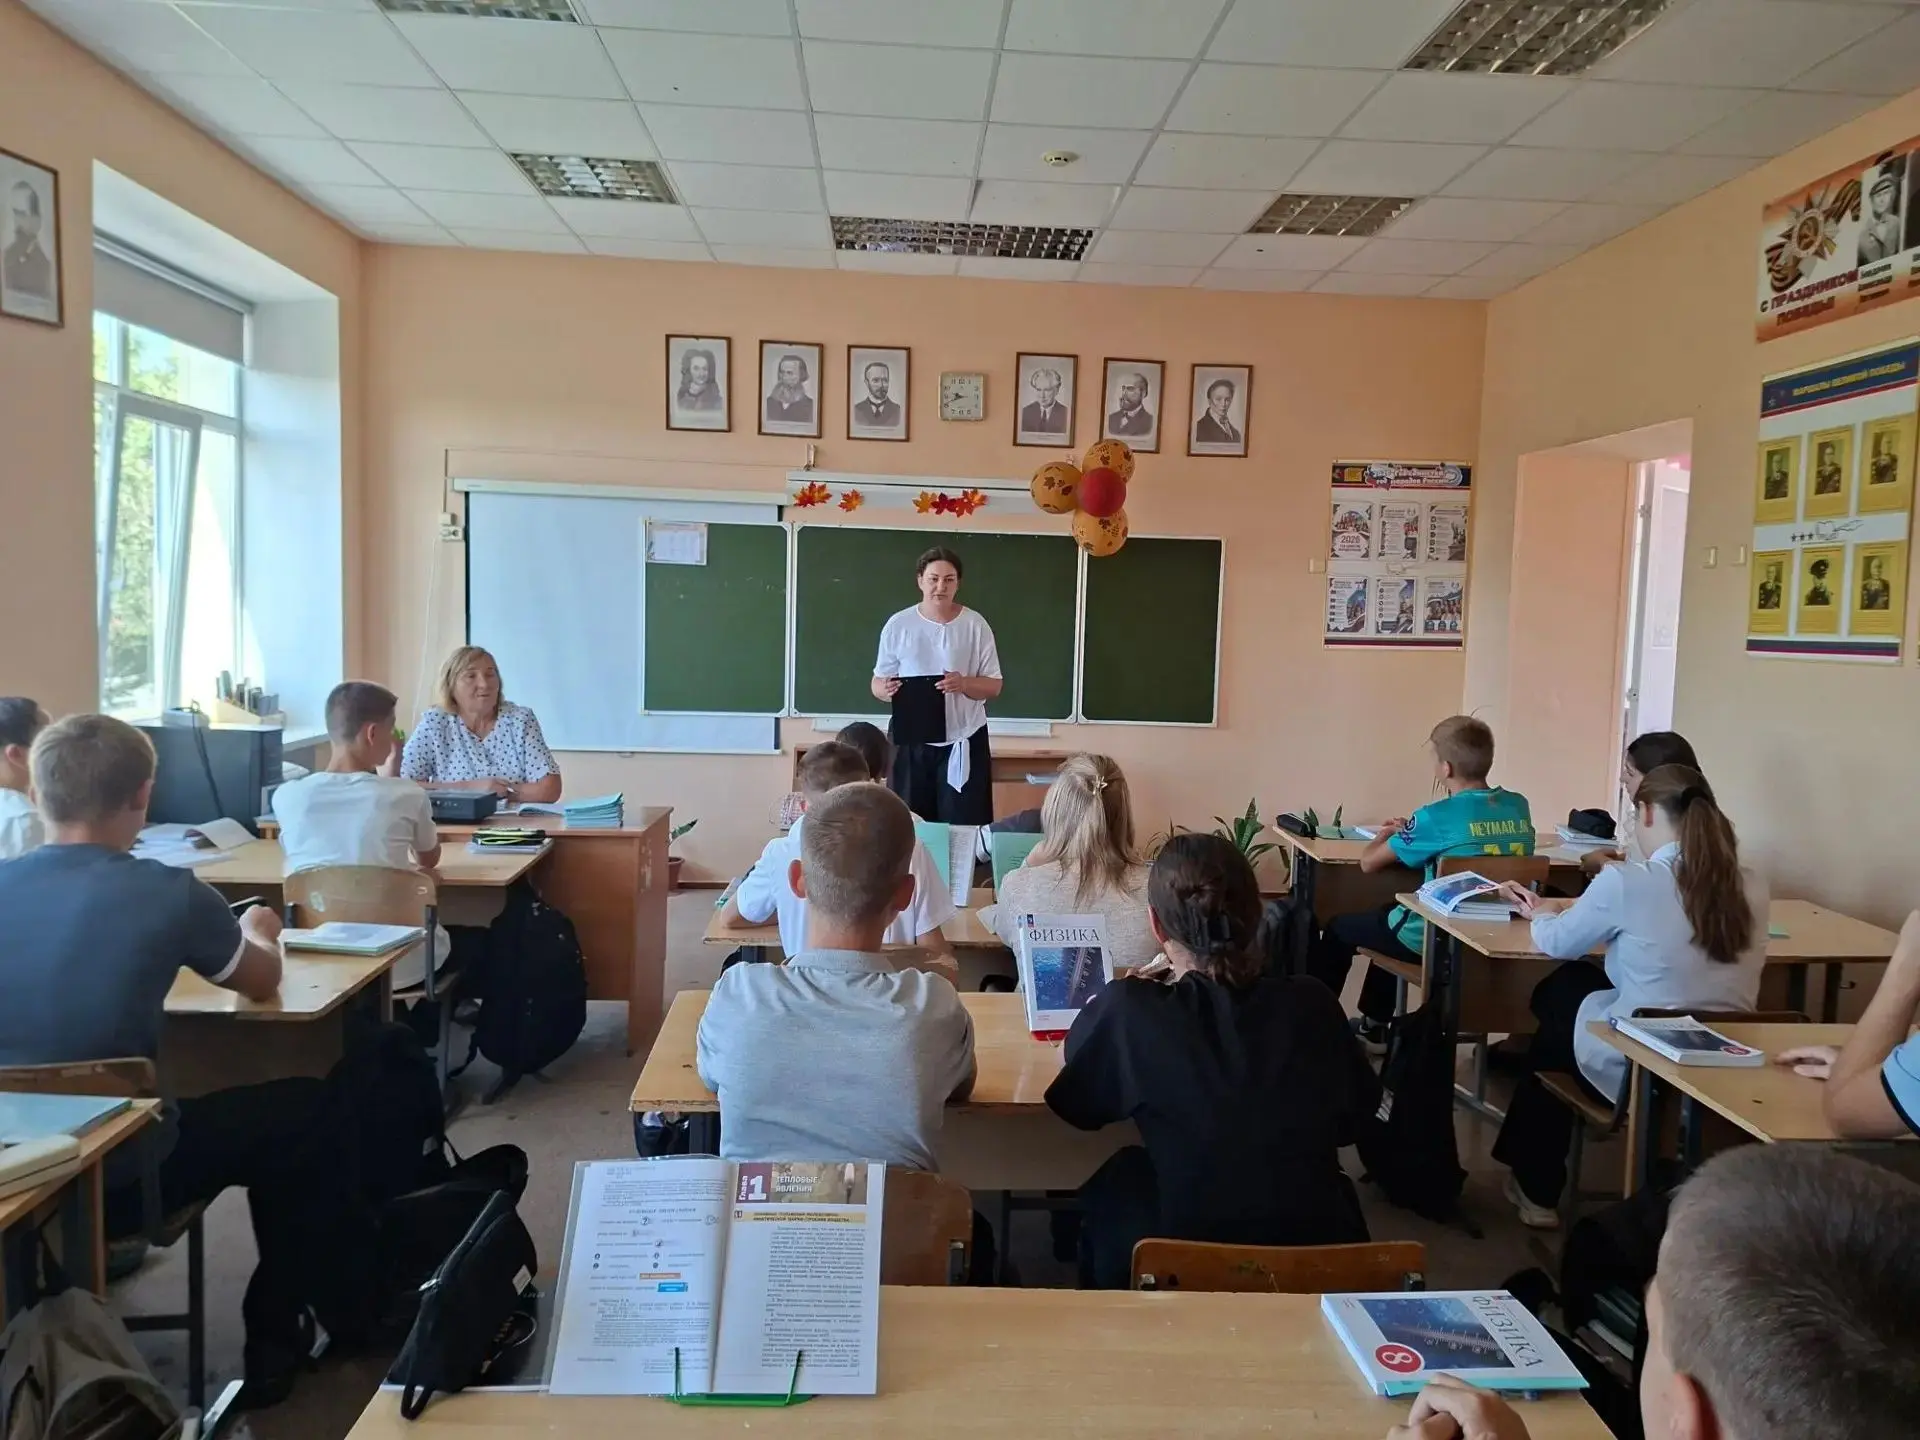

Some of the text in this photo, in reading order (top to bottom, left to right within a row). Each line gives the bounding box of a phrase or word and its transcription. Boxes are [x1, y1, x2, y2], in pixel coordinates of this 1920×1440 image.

[1771, 269, 1860, 310] ПРАЗДНИКОМ
[1470, 820, 1516, 837] NEYMAR
[1029, 928, 1100, 942] ФИЗИКА
[776, 1175, 819, 1184] ТЕПЛОВЫЕ
[748, 1175, 767, 1201] 1
[776, 1184, 813, 1193] ЯВЛЕНИЯ
[1473, 1296, 1543, 1367] ФИЗИКА
[1382, 1351, 1413, 1365] 8
